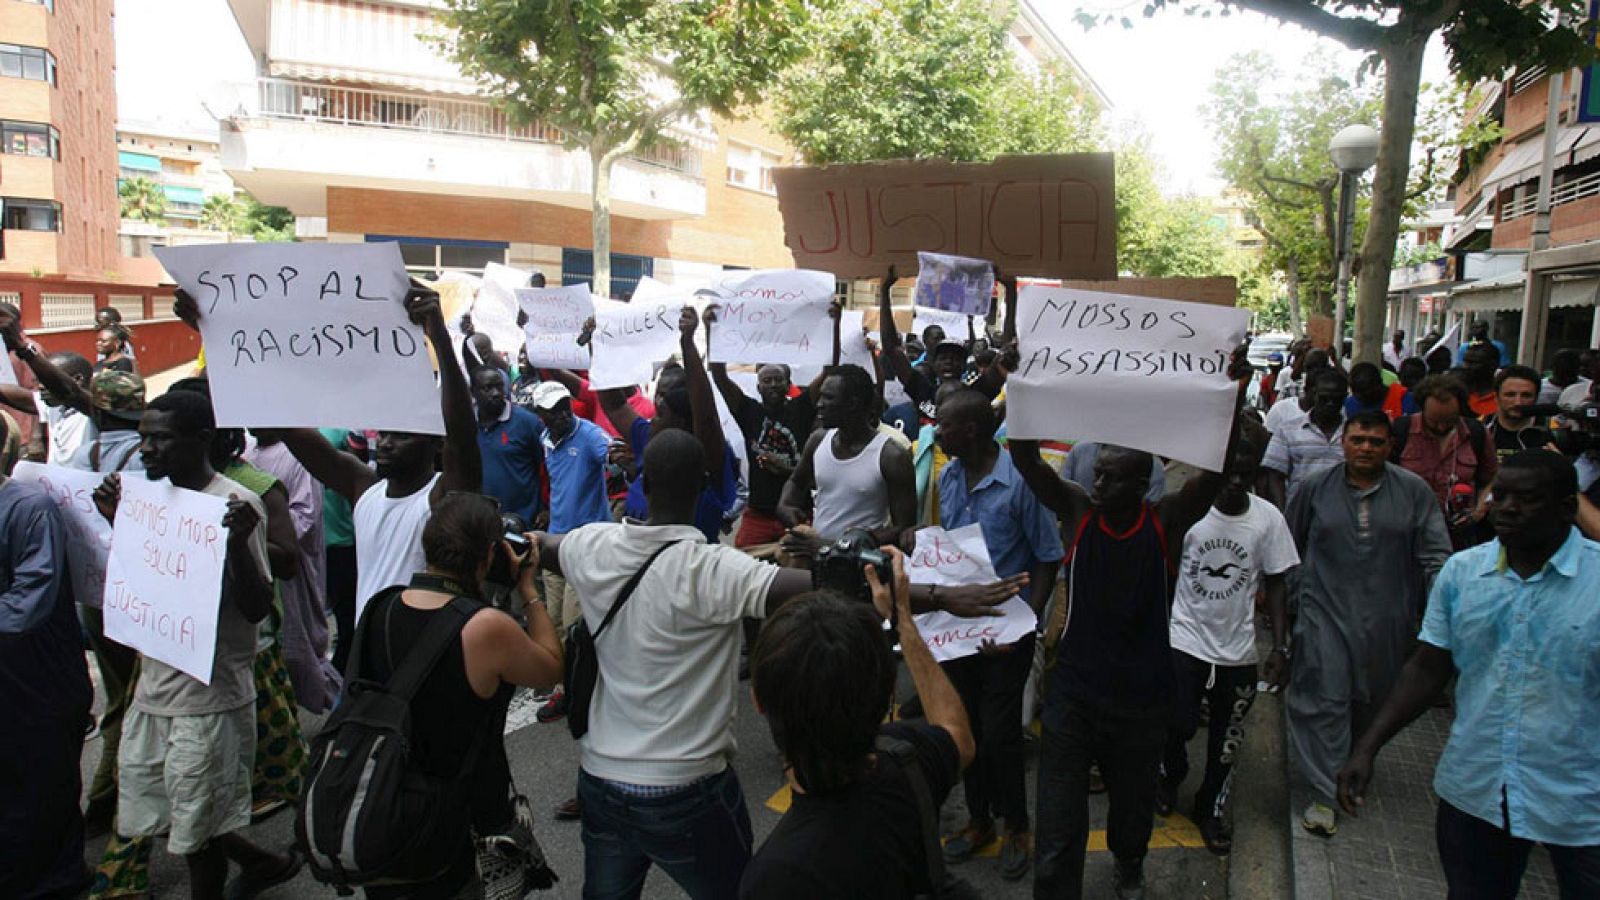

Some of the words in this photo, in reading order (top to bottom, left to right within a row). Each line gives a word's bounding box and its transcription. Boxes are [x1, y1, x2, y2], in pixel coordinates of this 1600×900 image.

[799, 176, 1099, 263] JUSTICIA
[198, 265, 299, 315] STOP
[319, 270, 390, 301] AL
[599, 304, 675, 344] KILLER
[1031, 299, 1196, 339] MOSSOS
[122, 489, 168, 537] SOMOS
[178, 515, 219, 562] MOR
[1198, 538, 1248, 560] HOLLISTER
[1208, 567, 1249, 600] CALIFORNIA
[107, 580, 196, 651] JUSTICIA
